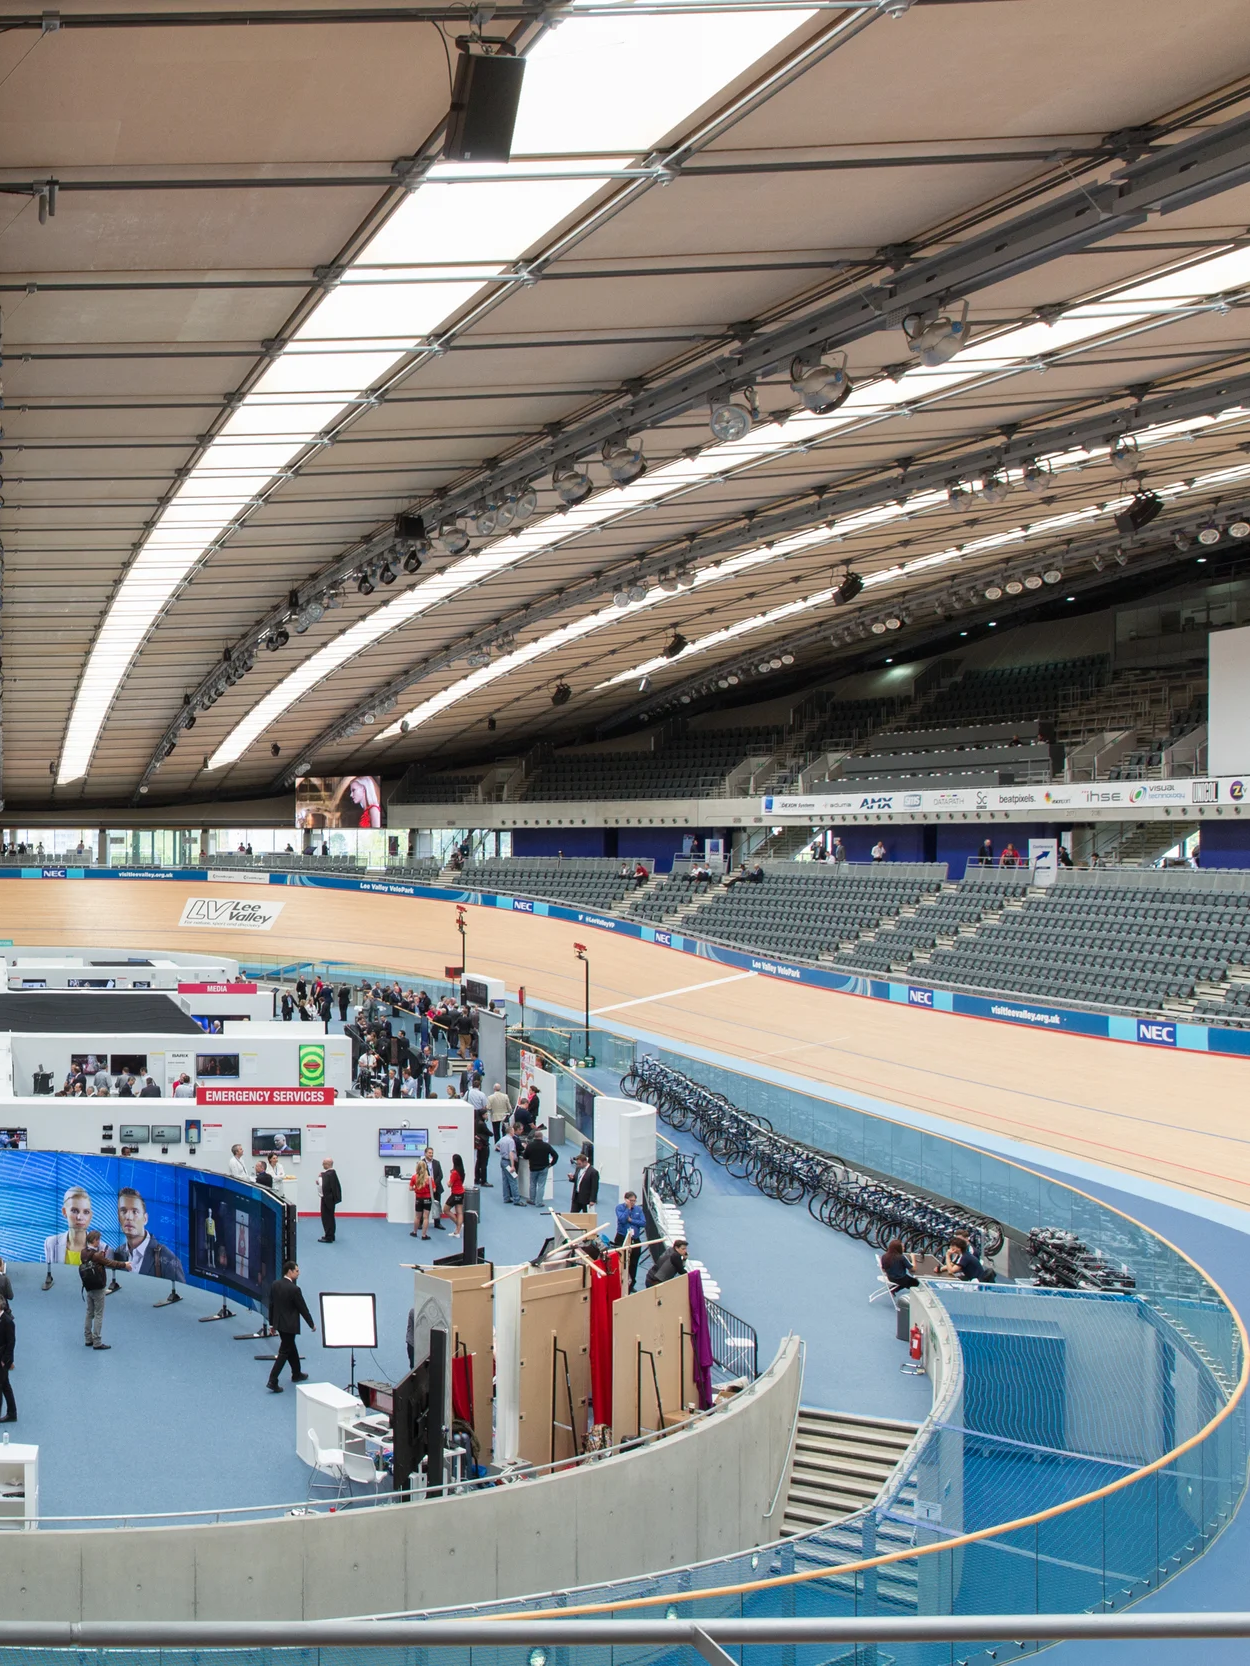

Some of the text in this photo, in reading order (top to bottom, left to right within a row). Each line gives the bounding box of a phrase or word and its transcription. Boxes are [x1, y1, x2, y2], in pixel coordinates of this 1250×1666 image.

[859, 796, 894, 810] AMX
[933, 798, 965, 806] DATAPATH
[118, 871, 173, 879] visitleevalley.org.uk
[360, 882, 370, 890] Lee
[371, 883, 389, 893] Valley
[232, 901, 261, 912] Lee
[514, 901, 532, 911] NEC
[229, 912, 272, 924] Valley
[655, 932, 671, 945] NEC
[752, 958, 801, 979] Lee Valley VeloPark
[207, 985, 227, 993] MEDIA
[909, 989, 932, 1005] NEC
[991, 1005, 1060, 1026] visitleevalley.org.uk
[1140, 1023, 1174, 1043] NEC
[205, 1090, 325, 1102] EMERGENCY SERVICES
